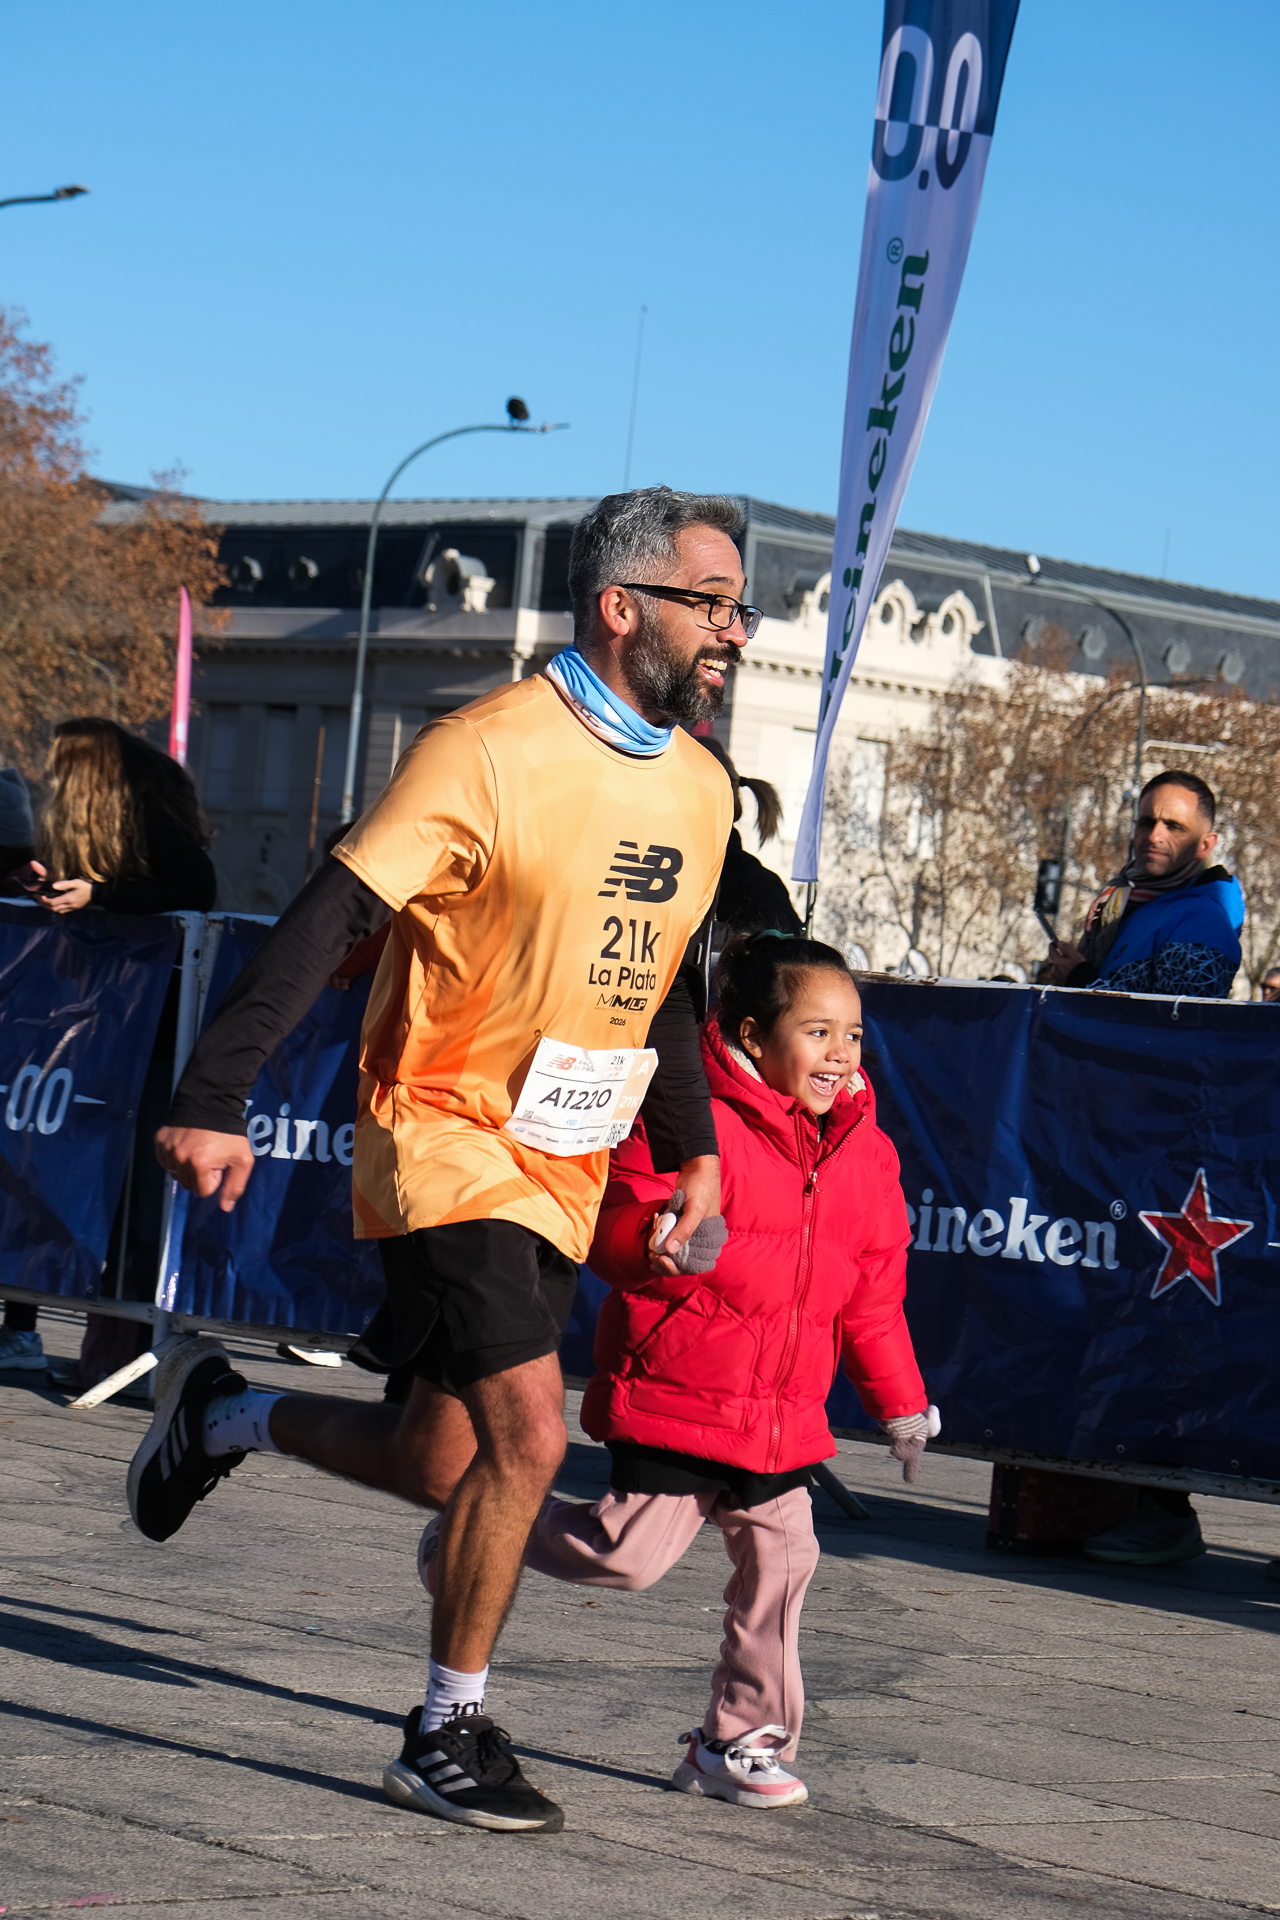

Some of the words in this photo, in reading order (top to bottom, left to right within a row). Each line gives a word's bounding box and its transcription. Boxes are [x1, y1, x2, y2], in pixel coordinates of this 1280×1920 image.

[872, 25, 983, 190] 0.0
[822, 237, 930, 722] eineken®
[588, 963, 612, 986] La
[617, 966, 657, 991] Plata
[5, 1064, 74, 1136] 0.0
[538, 1086, 612, 1110] A1220
[637, 1061, 649, 1075] A
[243, 1099, 355, 1166] eine
